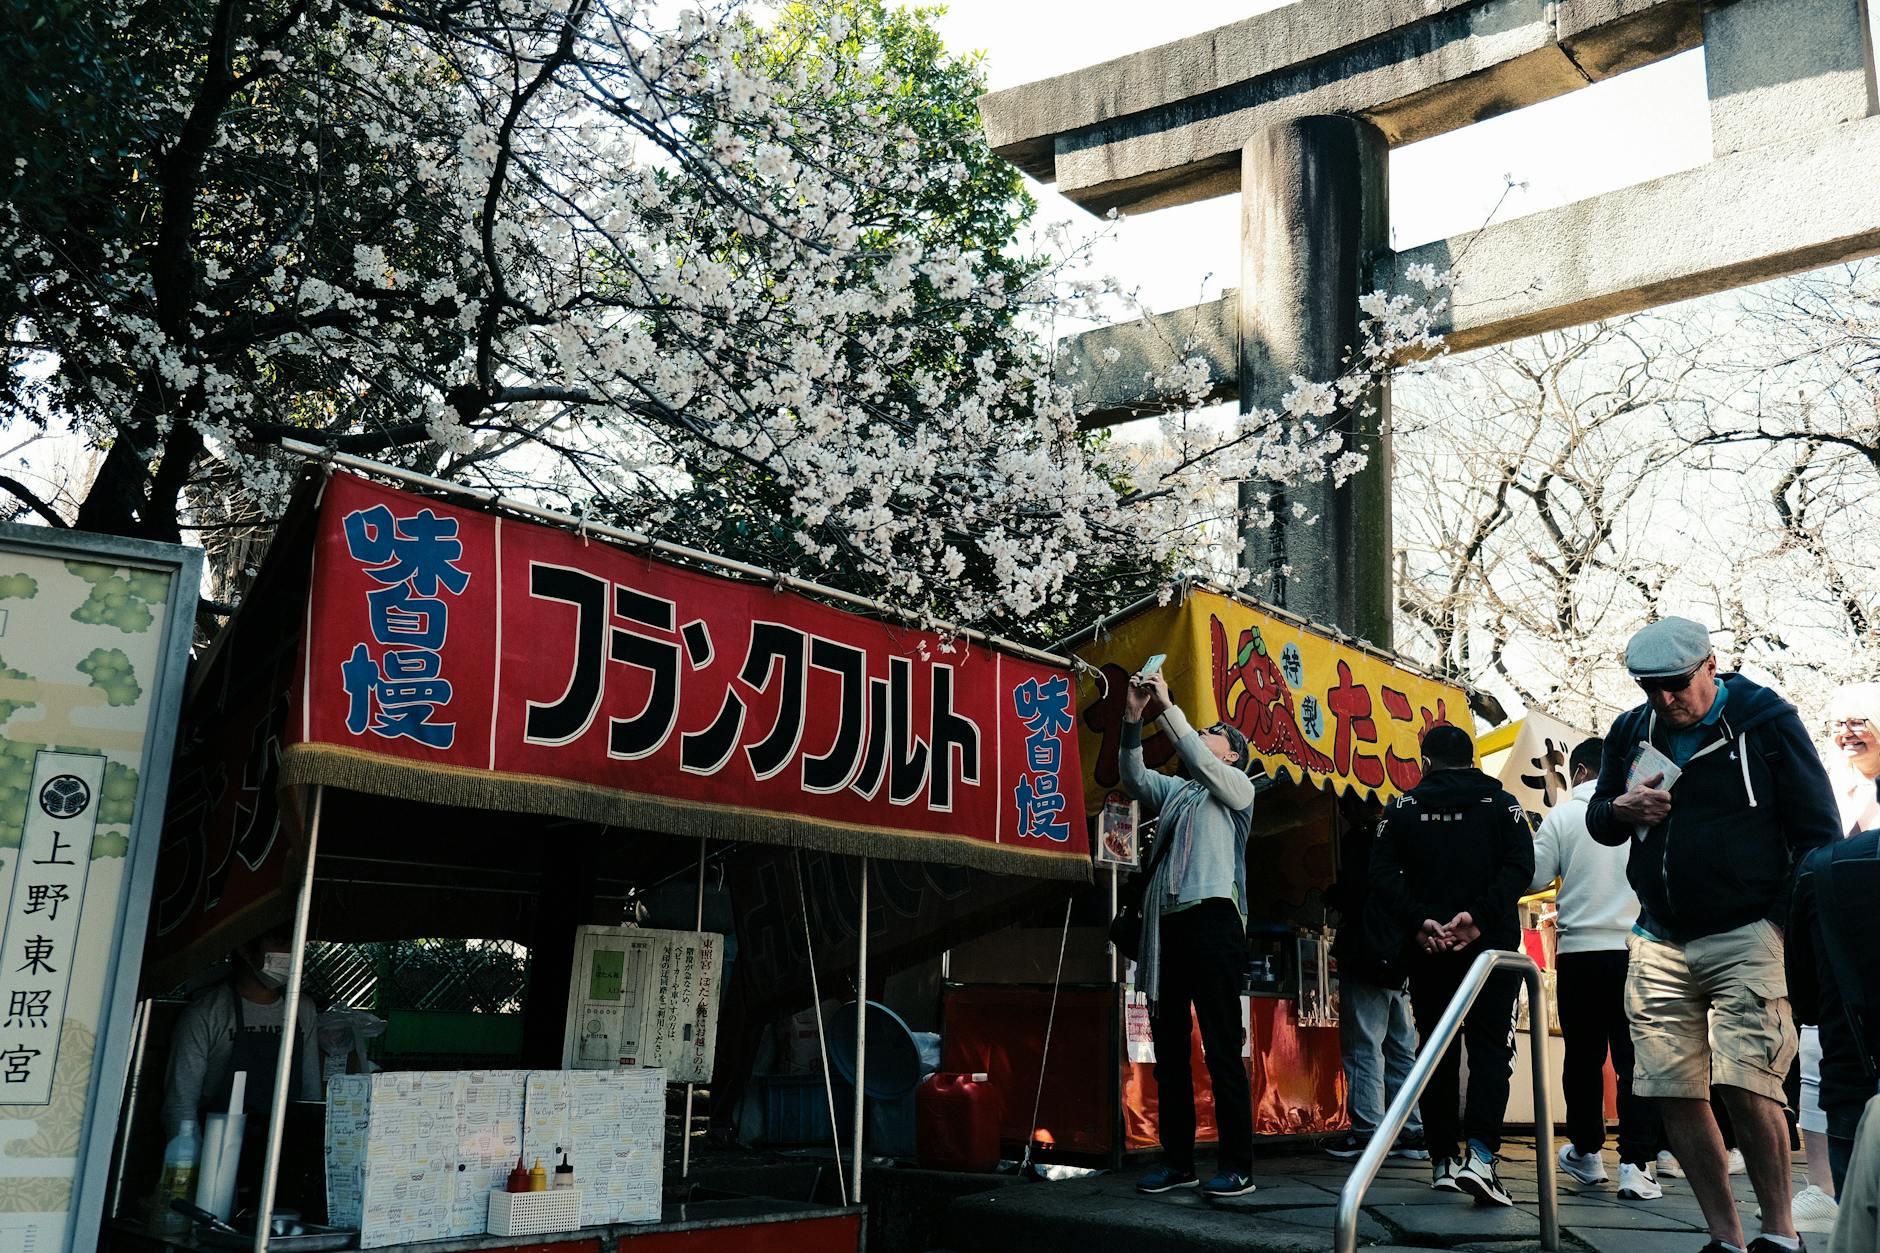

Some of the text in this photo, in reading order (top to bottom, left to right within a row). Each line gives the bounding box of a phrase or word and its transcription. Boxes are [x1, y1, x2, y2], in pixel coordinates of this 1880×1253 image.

[341, 502, 472, 750] 味自慢
[522, 558, 982, 814] フランクフルト
[1280, 644, 1321, 739] 特製
[1012, 673, 1074, 844] 味自慢
[0, 828, 77, 1085] 上野東照宮
